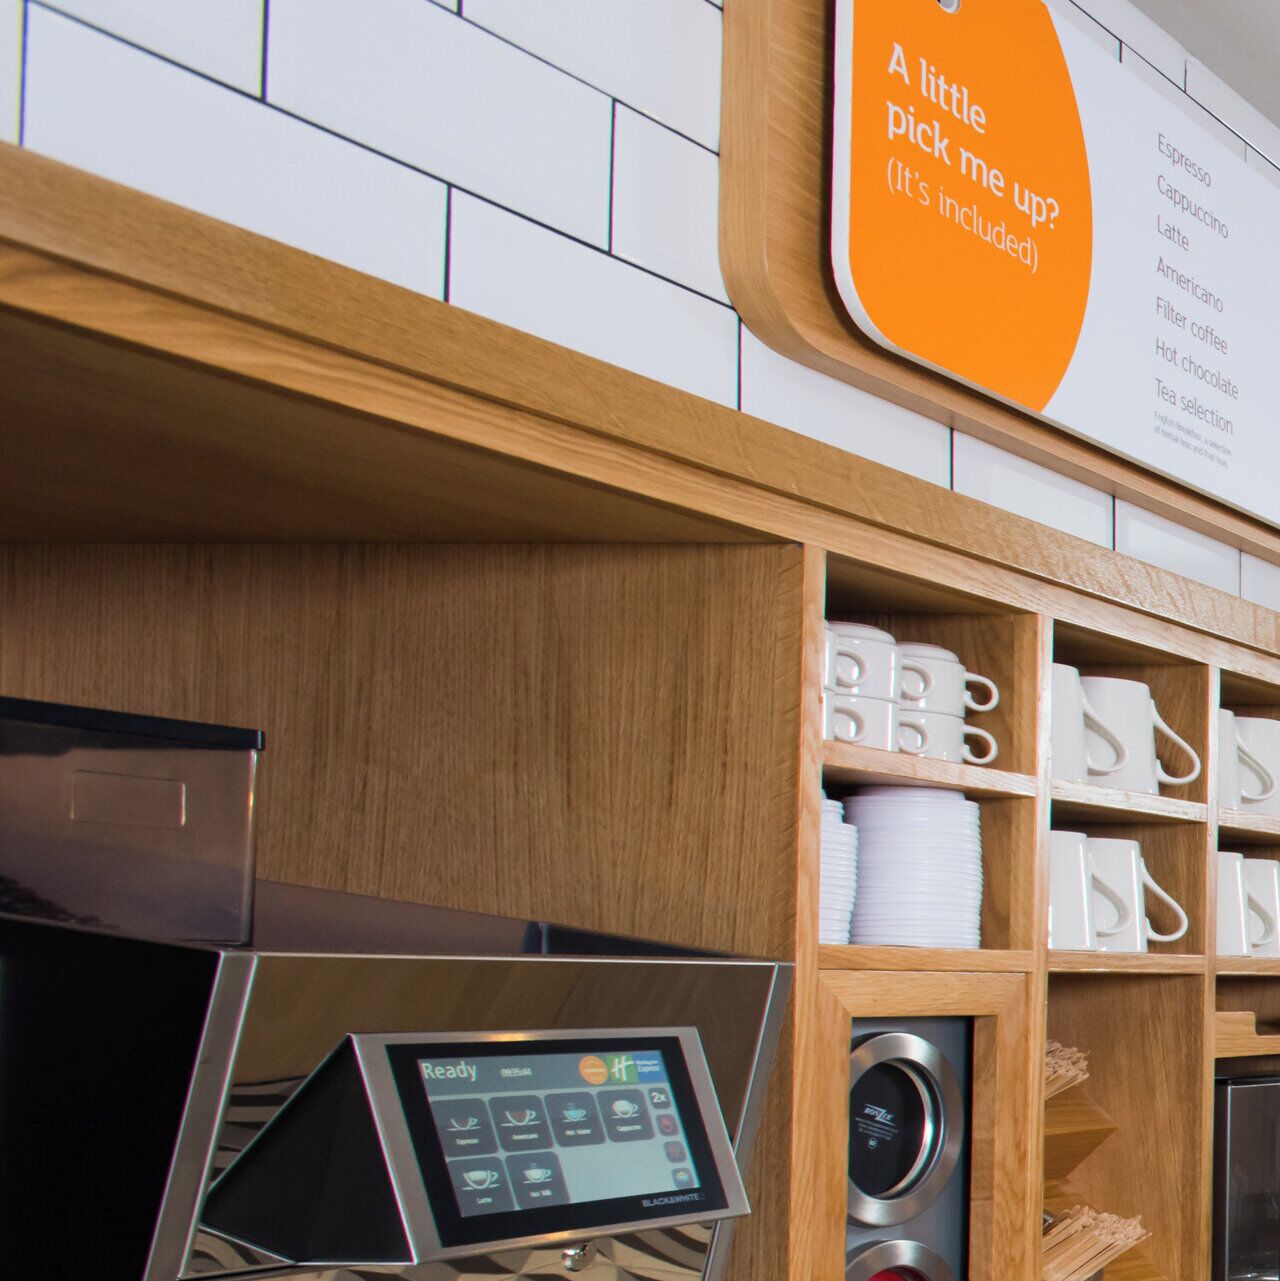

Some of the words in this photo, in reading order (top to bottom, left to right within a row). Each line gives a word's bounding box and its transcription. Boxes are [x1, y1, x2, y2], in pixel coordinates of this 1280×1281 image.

[888, 42, 910, 85] A
[919, 57, 987, 134] little
[886, 101, 951, 166] pick
[959, 147, 1005, 197] me
[1013, 182, 1060, 230] up?
[1157, 133, 1212, 187] Espresso
[939, 186, 1039, 274] included)
[1156, 214, 1190, 251] Latte
[1157, 174, 1229, 239] Cappuccino
[1156, 256, 1224, 313] Americano
[1155, 296, 1188, 331] Filter
[1190, 320, 1229, 355] coffee
[1155, 336, 1179, 367] Hot
[1181, 355, 1240, 400] chocolate
[1154, 377, 1177, 406] Tea
[1180, 397, 1235, 436] selection
[421, 1060, 477, 1082] Ready
[651, 1091, 668, 1103] 2x
